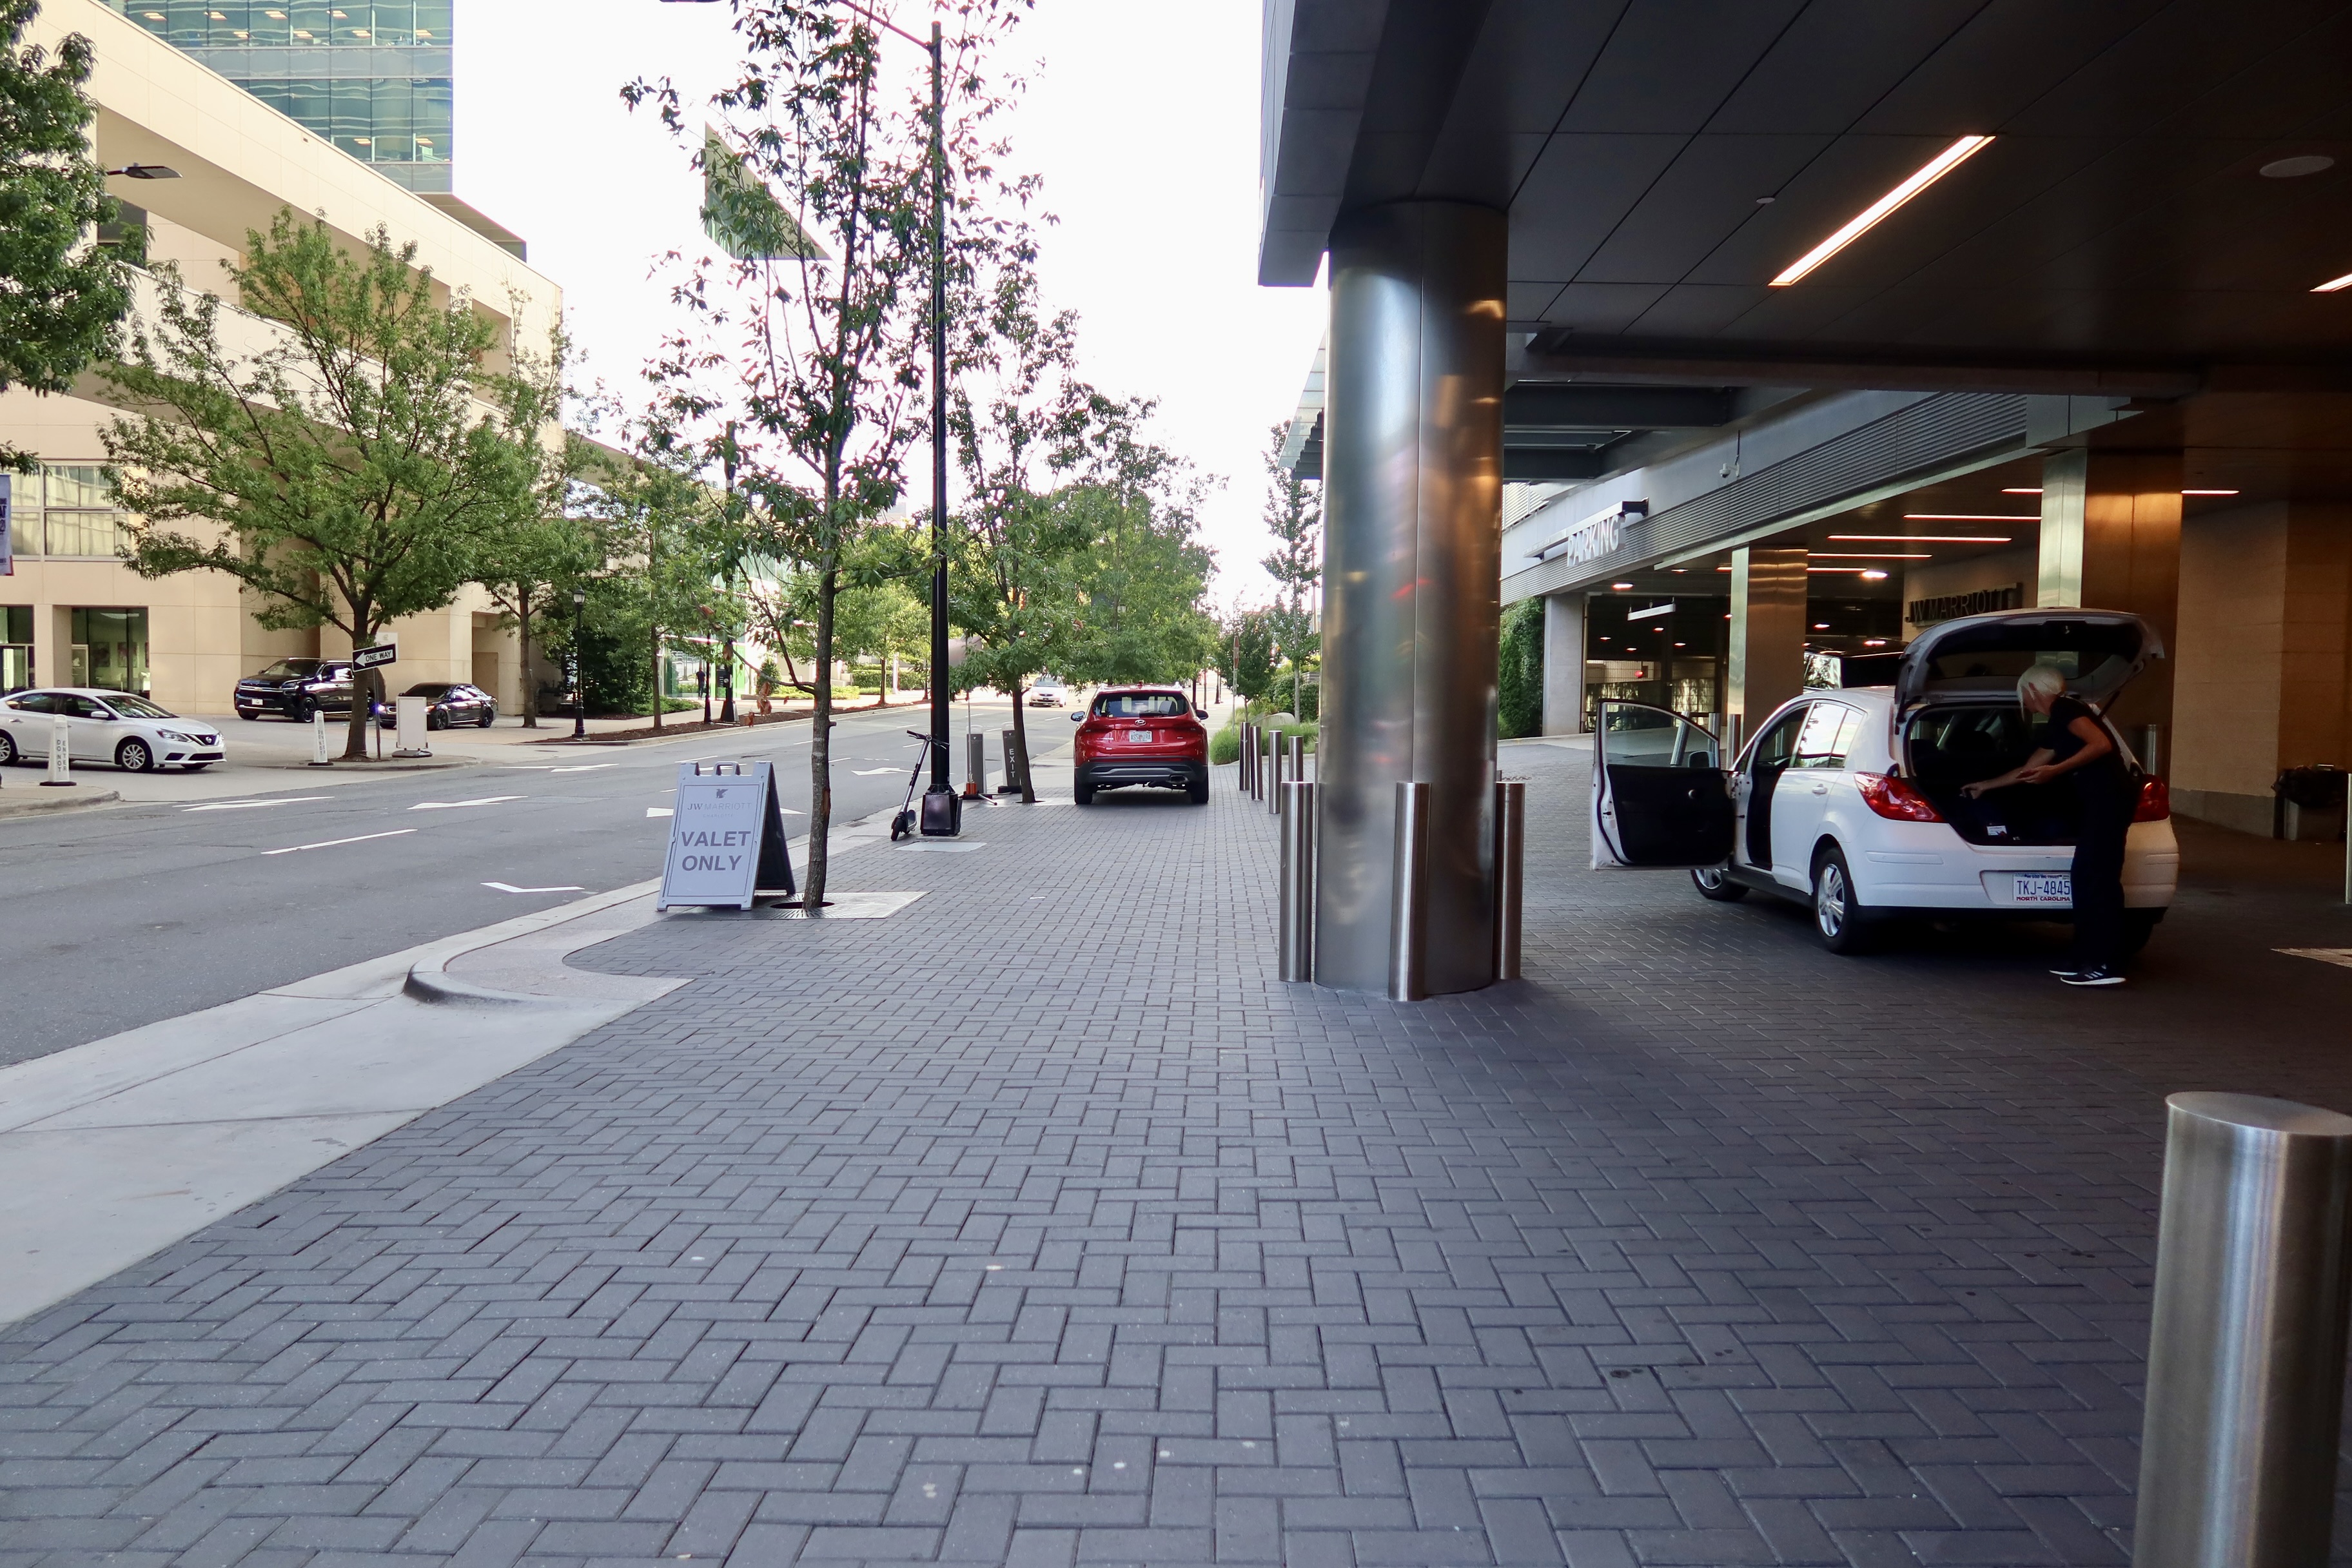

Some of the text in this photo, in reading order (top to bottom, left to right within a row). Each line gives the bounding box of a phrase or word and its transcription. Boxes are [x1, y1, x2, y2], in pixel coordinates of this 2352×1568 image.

[1567, 514, 1619, 567] PARKING
[379, 651, 391, 659] WAY
[681, 831, 751, 847] VALET
[682, 855, 742, 871] ONLY
[2017, 881, 2070, 895] TKJ-4845
